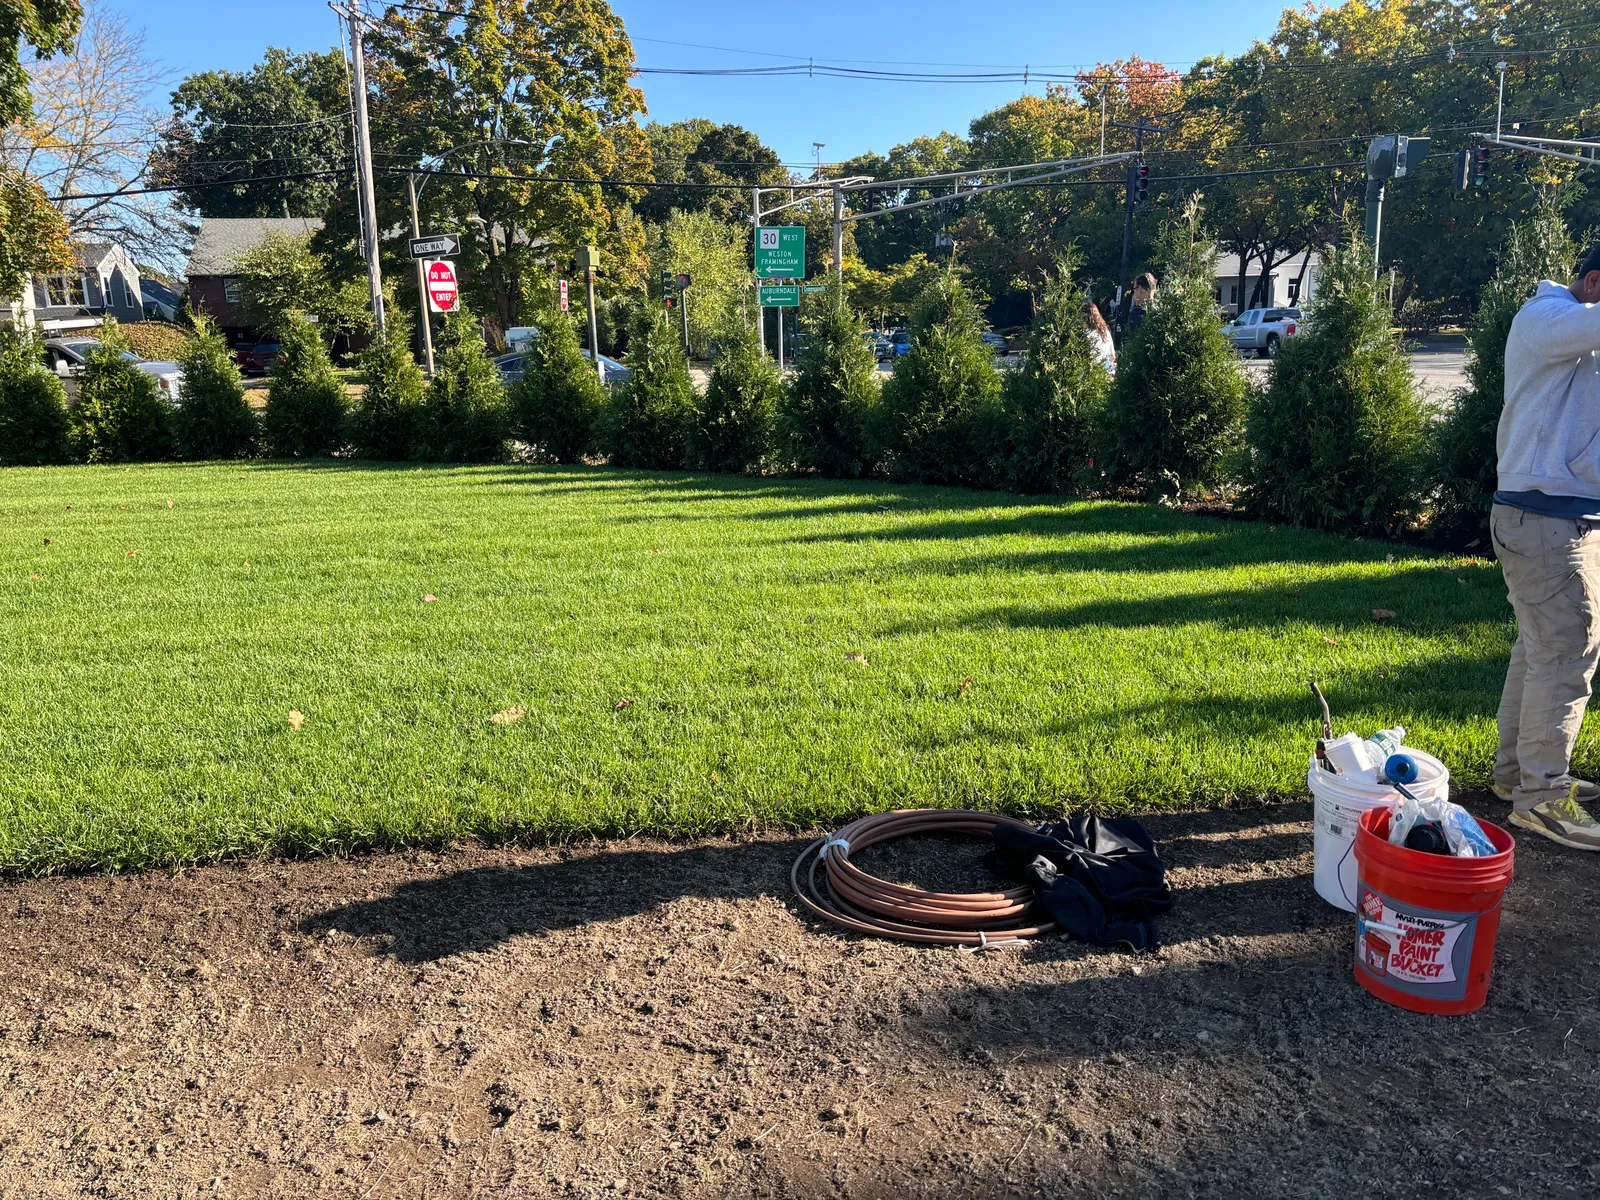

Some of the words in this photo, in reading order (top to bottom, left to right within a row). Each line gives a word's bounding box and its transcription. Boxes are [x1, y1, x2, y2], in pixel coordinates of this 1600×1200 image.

[415, 243, 428, 253] ONE
[430, 242, 444, 251] WAY
[763, 233, 776, 245] 30
[1363, 896, 1384, 913] HOME
[1399, 939, 1441, 963] PAINT
[1391, 953, 1445, 978] BUCKET
